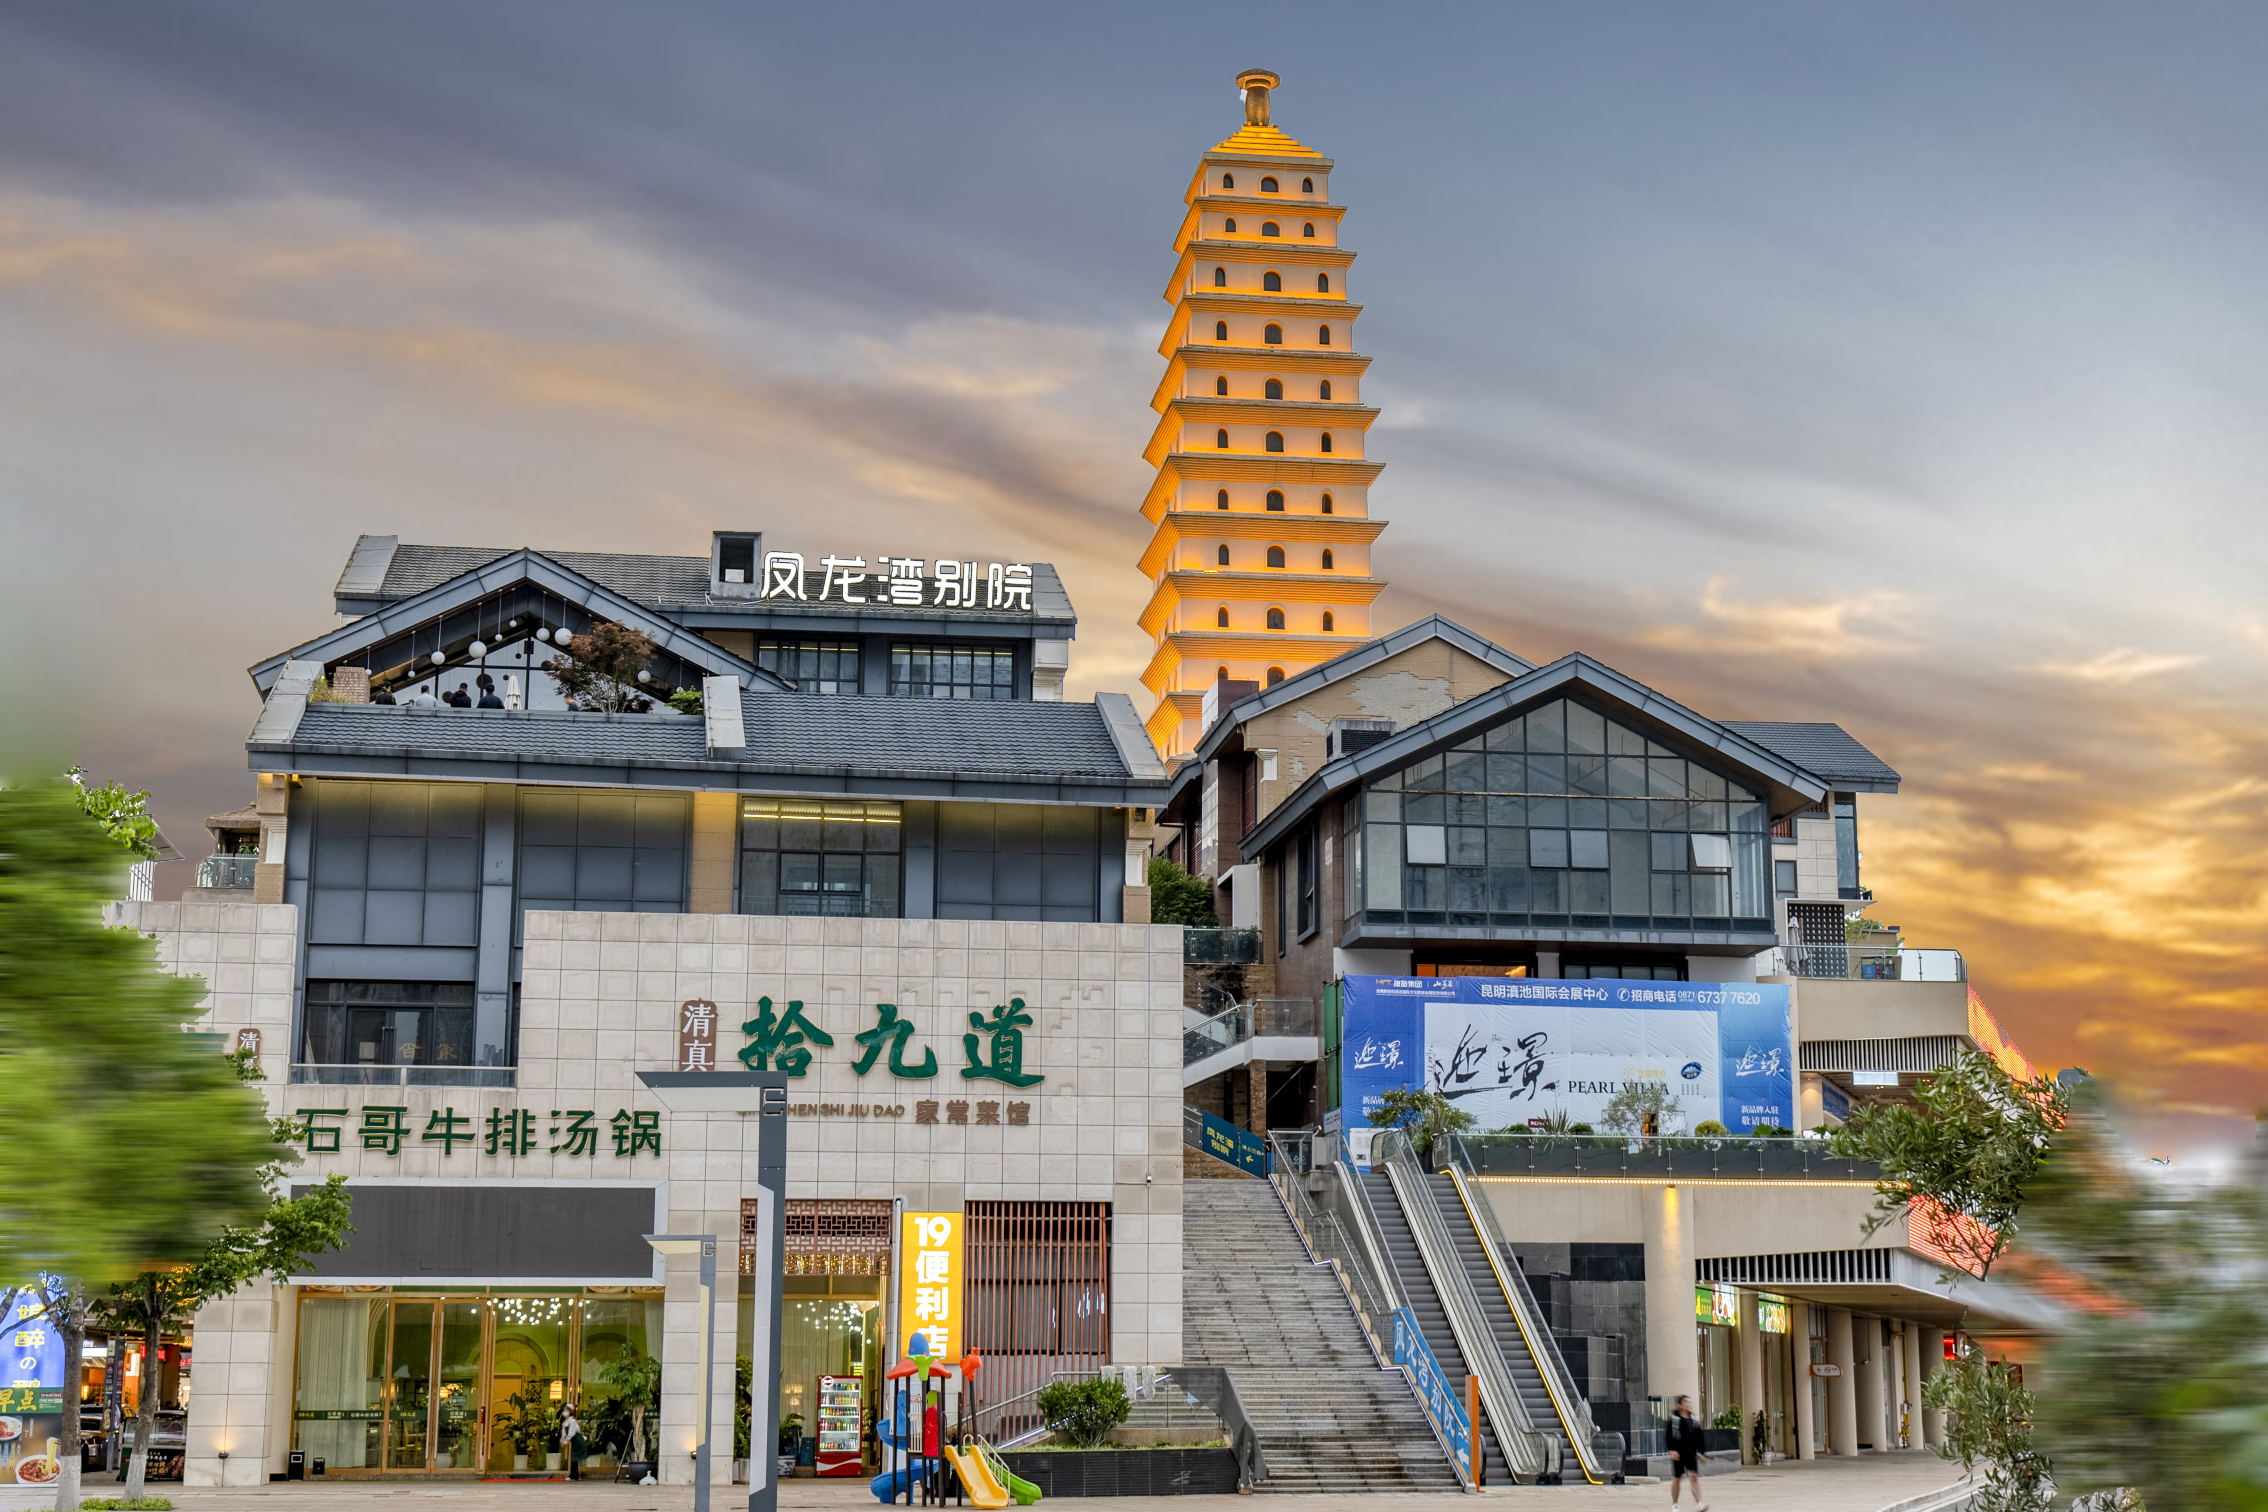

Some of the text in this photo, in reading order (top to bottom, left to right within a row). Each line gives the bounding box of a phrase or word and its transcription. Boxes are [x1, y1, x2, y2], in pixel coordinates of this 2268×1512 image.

[761, 551, 1033, 610] 凤龙湾别院
[1481, 984, 1609, 1001] 昆明滇池国际会展中心
[1631, 989, 1761, 1005] 招商电话 0871 6737 7620
[682, 1004, 715, 1071] 清真
[738, 996, 1046, 1088] 拾九道
[1568, 1081, 1618, 1094] PEARL
[848, 1104, 870, 1117] JIU
[873, 1104, 906, 1117] DAO
[915, 1101, 1031, 1125] 家常菜馆
[1741, 1116, 1780, 1126] 敬请期待
[296, 1106, 662, 1158] 石哥牛排汤锅
[1206, 1126, 1234, 1150] 凤龙湾
[1211, 1139, 1230, 1157] 别院
[1394, 1321, 1456, 1438] 凤龙湾别院
[0, 1388, 37, 1413] 早点
